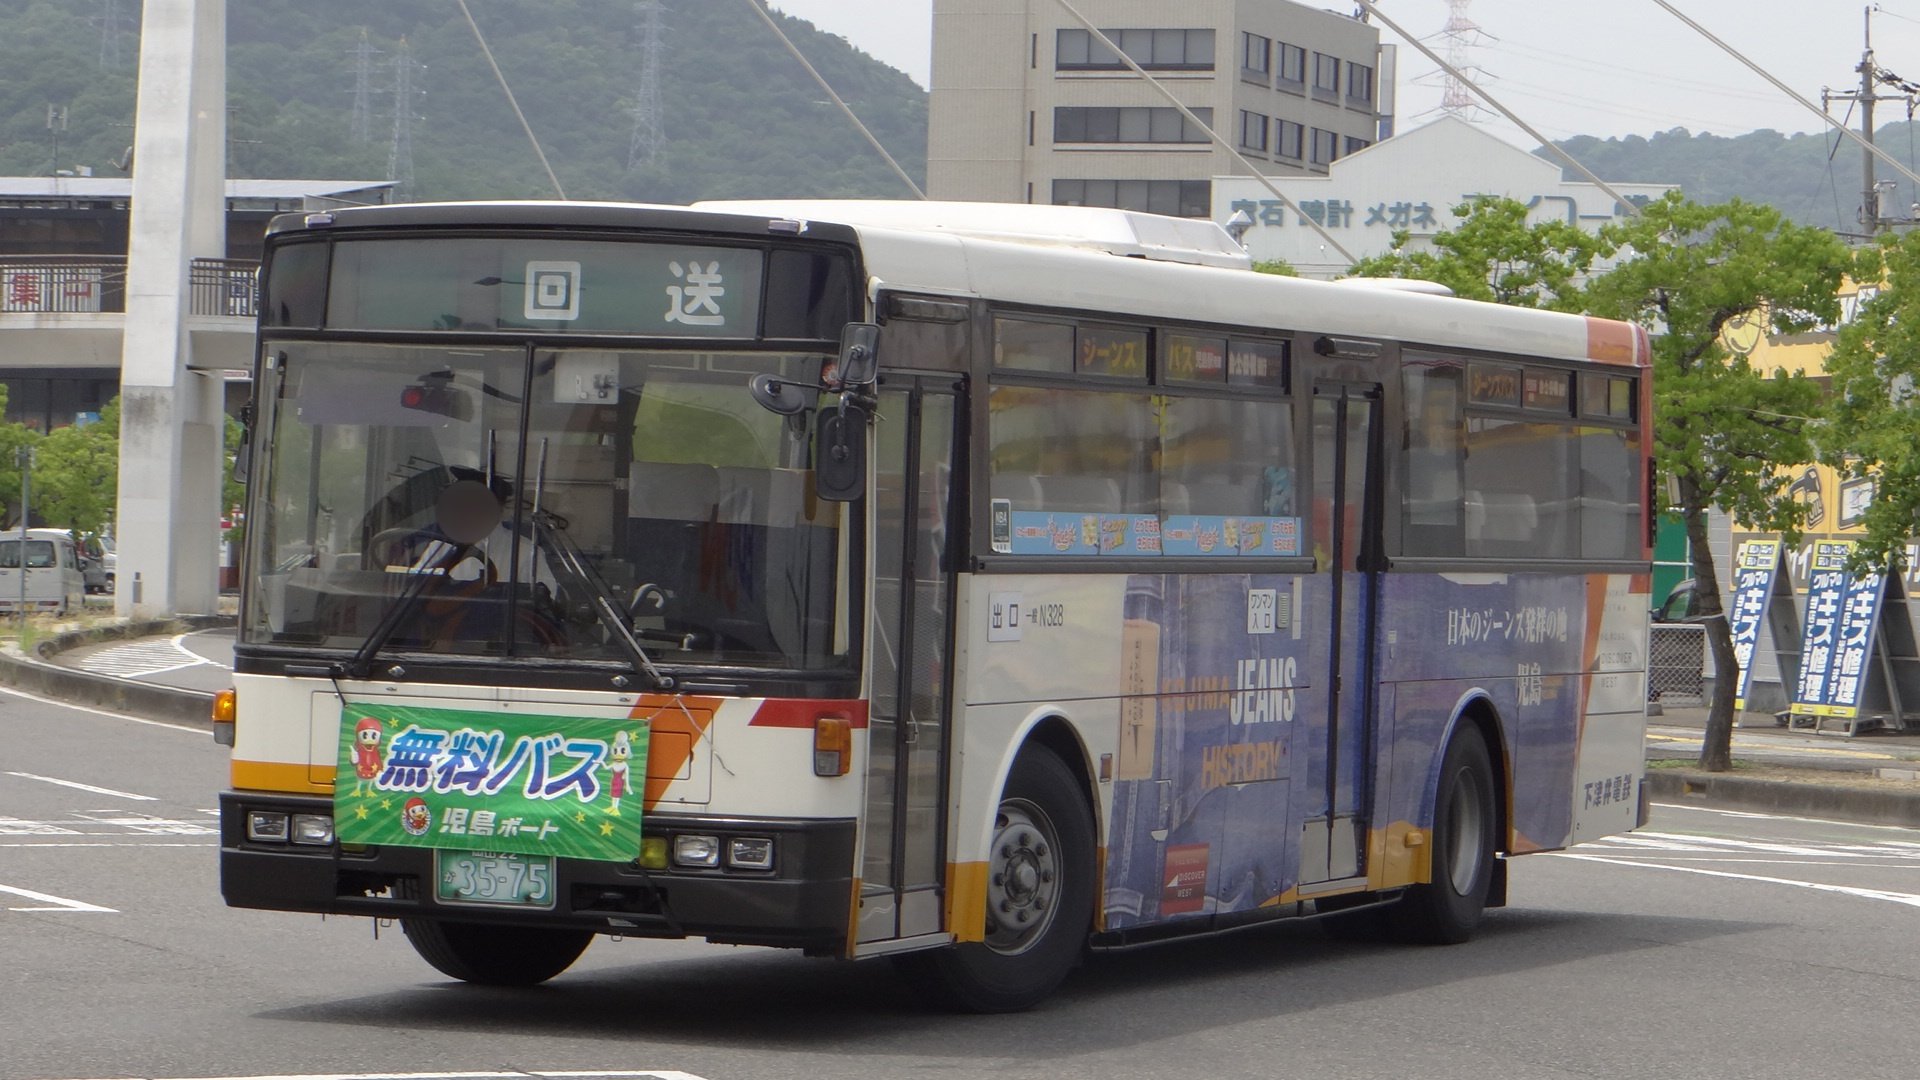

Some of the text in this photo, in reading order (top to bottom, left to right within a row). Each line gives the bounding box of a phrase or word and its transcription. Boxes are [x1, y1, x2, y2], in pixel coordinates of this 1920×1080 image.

[1364, 202, 1437, 229] メガネ
[524, 260, 725, 326] 回送
[1083, 338, 1138, 367] ジーンズ
[1168, 343, 1195, 371] バス
[1740, 571, 1768, 589] クルマの
[1813, 572, 1842, 590] クルマの
[992, 603, 1019, 629] 出口
[1040, 604, 1064, 626] N328
[1250, 594, 1274, 609] ワンマン
[1251, 613, 1271, 629] 入口
[1447, 607, 1568, 646] 日本のジーンズ発祥の地
[1803, 589, 1839, 702] キズ修理
[1835, 591, 1875, 704] キズ修理
[1161, 675, 1230, 713] KOJIMA
[1230, 656, 1297, 725] JEANS
[1517, 662, 1543, 707] 児島
[376, 725, 608, 802] 無料バス
[1200, 740, 1283, 790] HISTORY
[439, 807, 560, 840] 児島ボート
[457, 860, 548, 900] 35-75
[1178, 870, 1206, 882] DISCOVER
[1177, 888, 1193, 898] WEST
